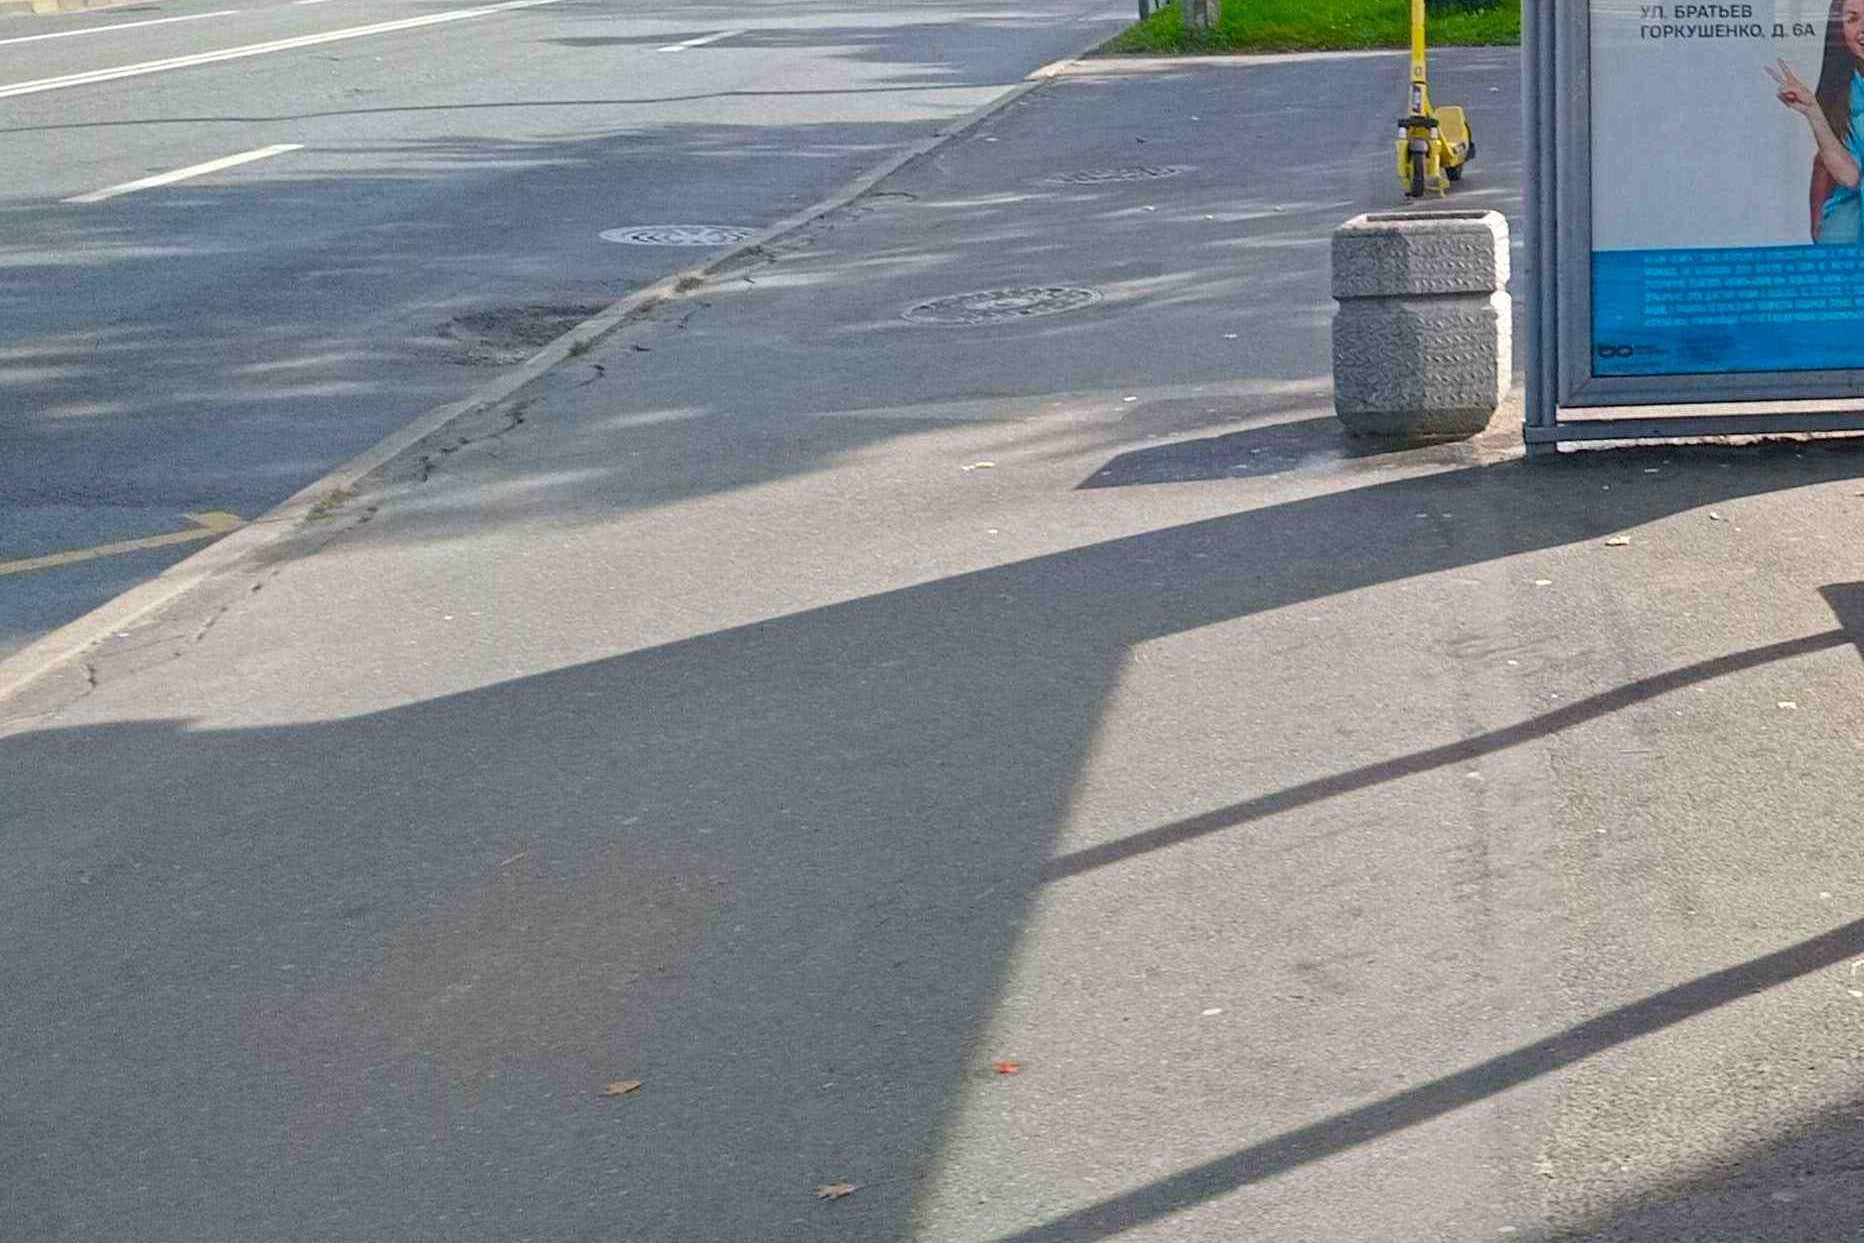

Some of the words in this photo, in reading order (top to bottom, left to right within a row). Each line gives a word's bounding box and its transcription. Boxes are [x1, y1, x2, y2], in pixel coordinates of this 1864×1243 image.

[1674, 4, 1753, 19] БРАТЬЕВ
[1771, 23, 1789, 38] Д.
[1792, 23, 1815, 37] 6А
